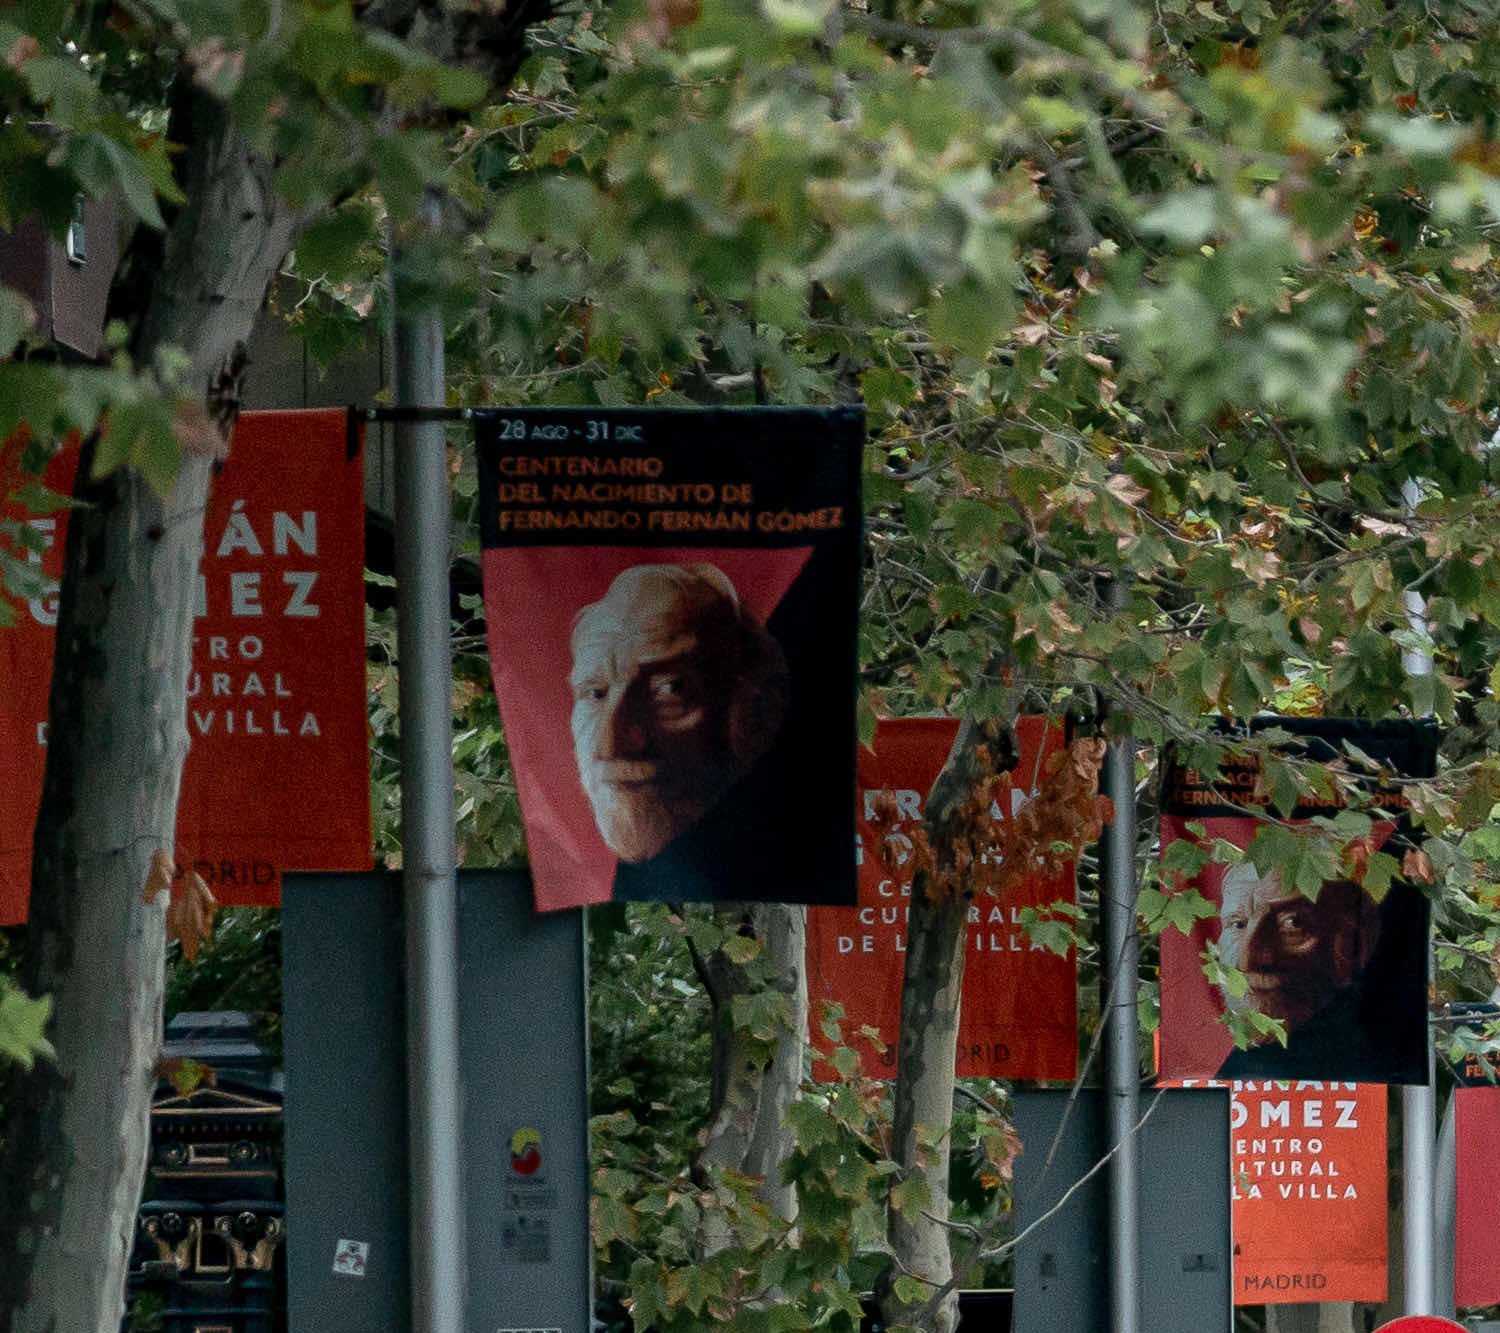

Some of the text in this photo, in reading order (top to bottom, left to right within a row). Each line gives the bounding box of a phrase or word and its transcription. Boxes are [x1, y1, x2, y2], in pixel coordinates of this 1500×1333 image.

[498, 419, 526, 441] 28
[530, 425, 569, 441] AGO
[586, 420, 608, 441] 31
[615, 425, 645, 441] DIC
[498, 456, 665, 477] CENTENARIO
[498, 483, 753, 504] DEL NACIMIENTO DE
[498, 505, 845, 532] FERNANDO FERNÁN GÓMEZ
[193, 709, 321, 736] VILLA
[838, 935, 875, 953] DE
[1231, 1093, 1359, 1129] ÓMEZ
[1236, 1138, 1324, 1154] ENTRO
[1239, 1160, 1340, 1177] LTURAL
[1279, 1183, 1358, 1200] VILLA
[1245, 1274, 1328, 1291] MADRID
